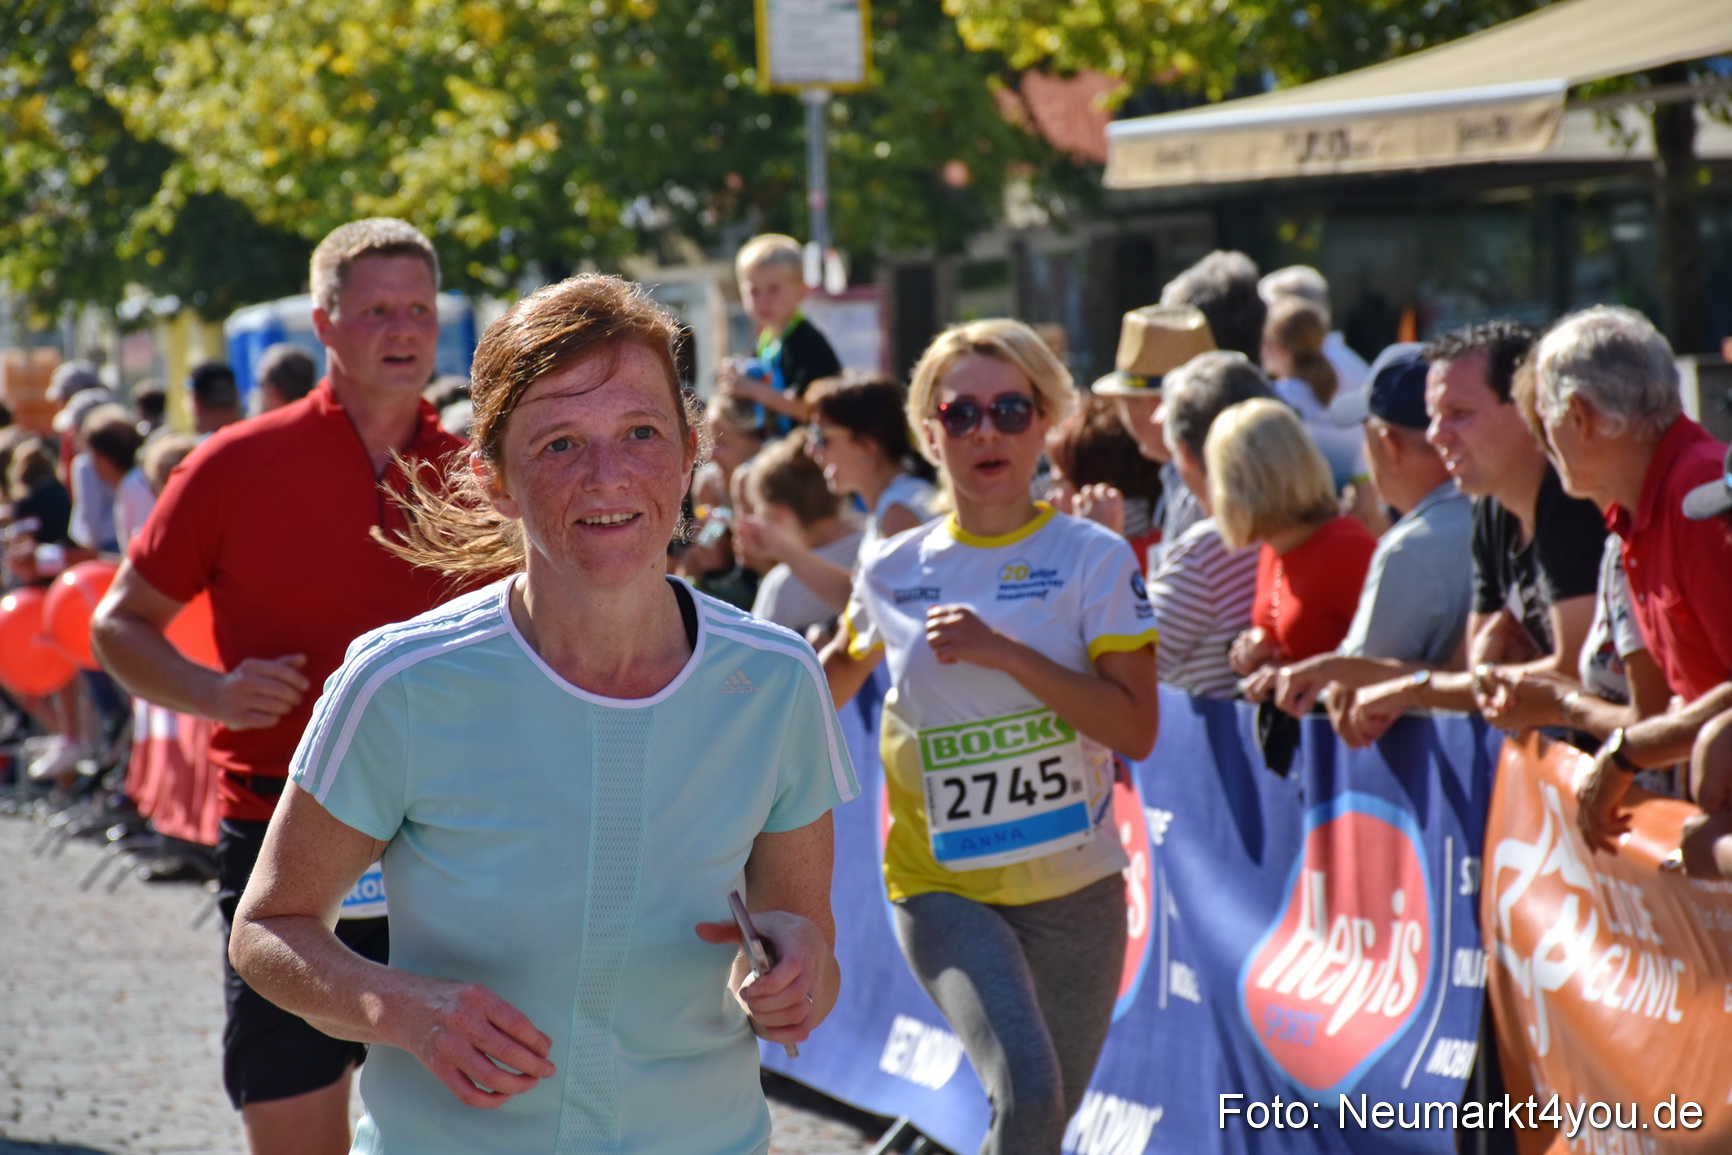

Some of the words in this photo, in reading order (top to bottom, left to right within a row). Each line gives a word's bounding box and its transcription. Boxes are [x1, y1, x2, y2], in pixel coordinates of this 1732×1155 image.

[1001, 564, 1029, 582] 20
[929, 712, 1062, 764] BOCK
[943, 756, 1068, 822] 2745
[960, 827, 1026, 851] ANNA
[1256, 866, 1423, 1037] Hervis
[1263, 1003, 1324, 1047] SPORTS
